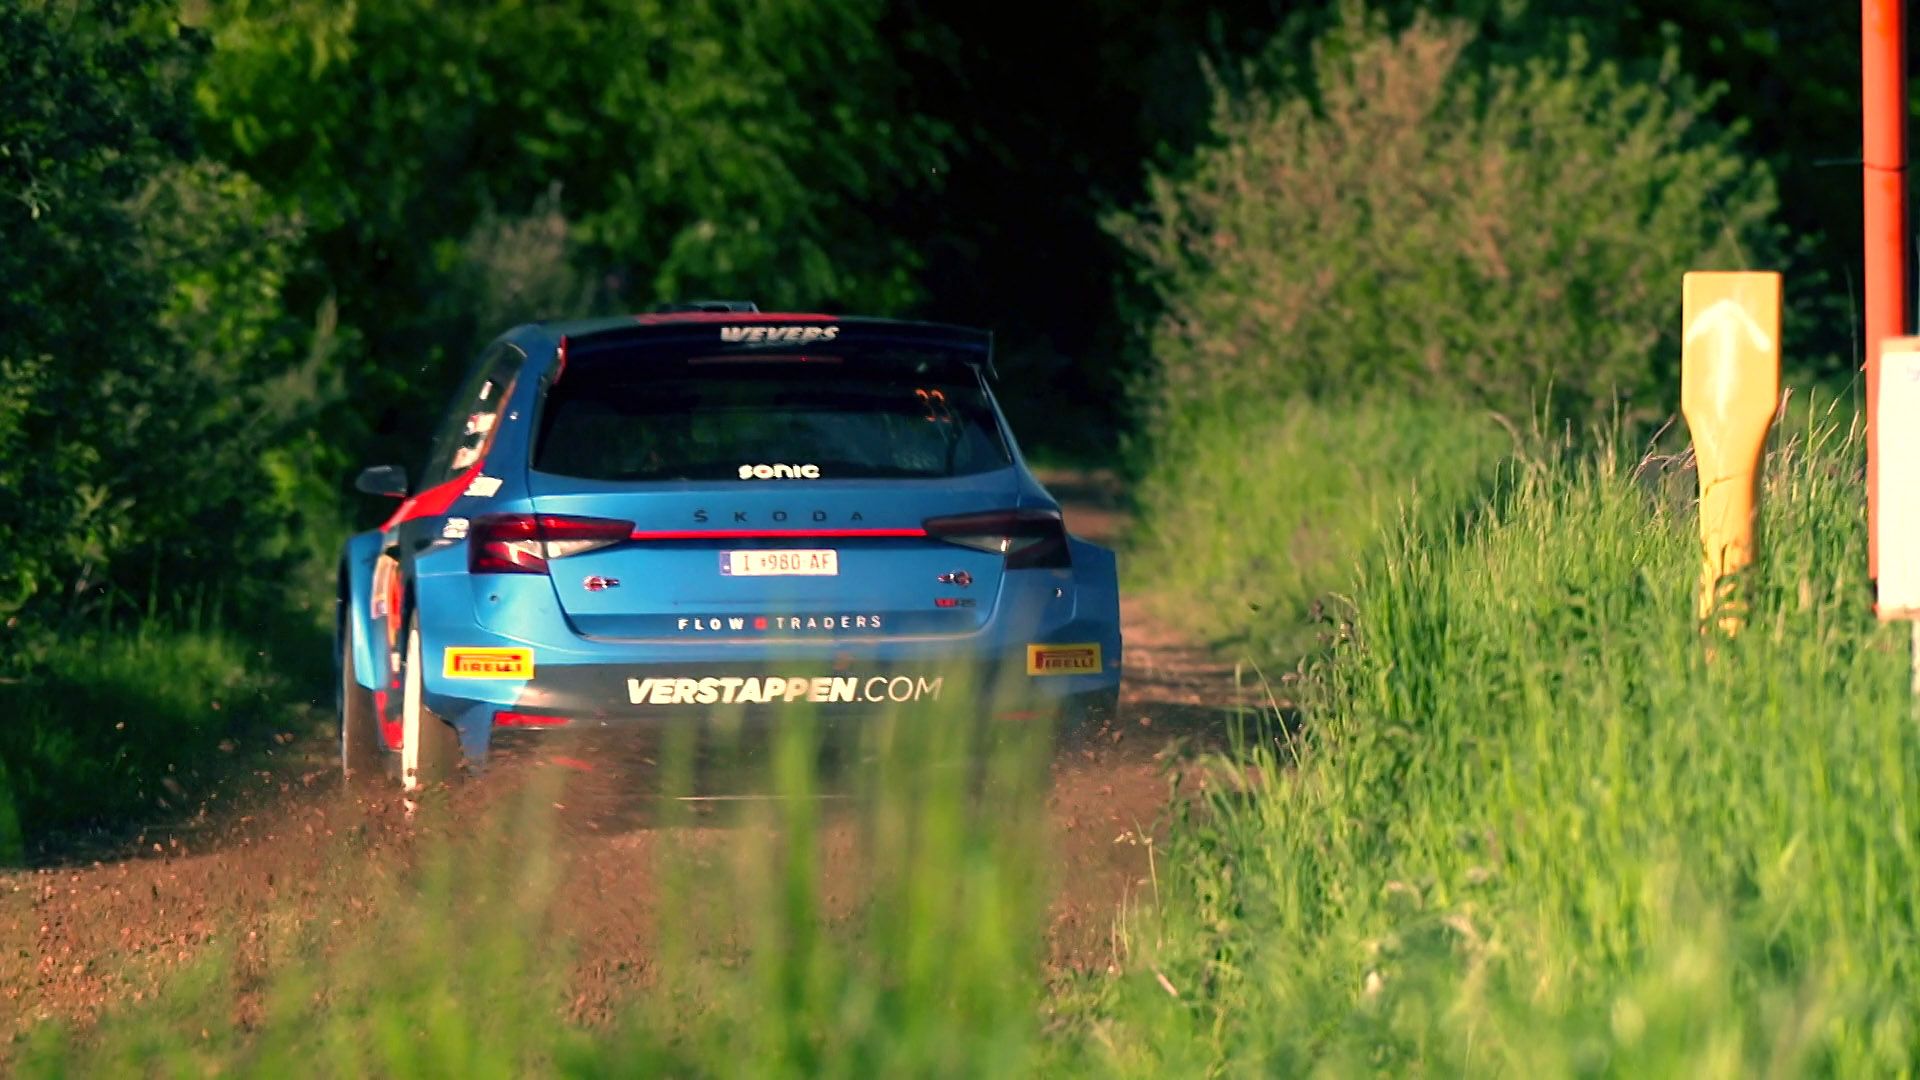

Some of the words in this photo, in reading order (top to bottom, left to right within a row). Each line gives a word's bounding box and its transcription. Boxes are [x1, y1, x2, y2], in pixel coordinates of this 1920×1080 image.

[721, 326, 839, 342] WEVERS
[677, 616, 745, 631] FLOW
[775, 615, 881, 630] TRADERS
[454, 654, 522, 672] PIRELLI
[1035, 648, 1094, 669] PIRELLI
[627, 676, 944, 705] VERSTAPPEN.COM
